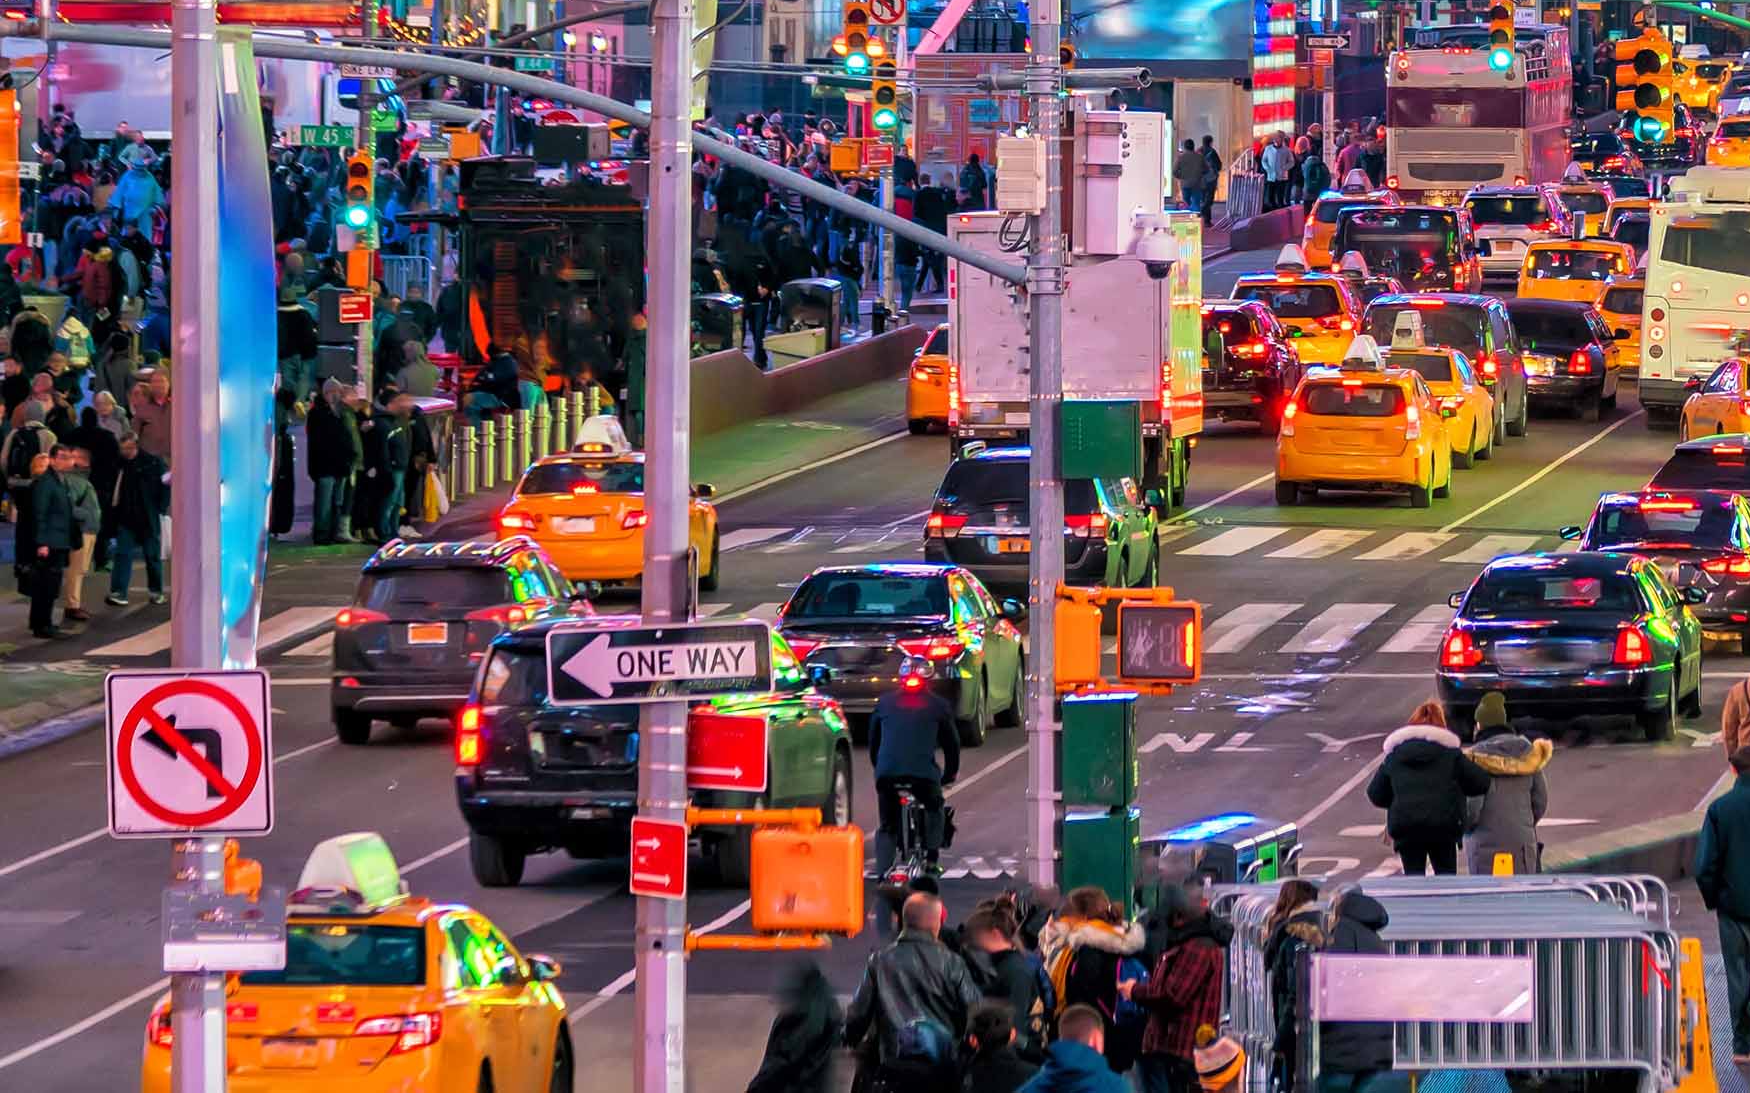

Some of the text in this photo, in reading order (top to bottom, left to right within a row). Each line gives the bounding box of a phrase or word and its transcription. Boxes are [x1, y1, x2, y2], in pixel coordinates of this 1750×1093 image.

[304, 129, 316, 143] W
[322, 129, 339, 144] 45
[617, 646, 746, 677] ONE WAY
